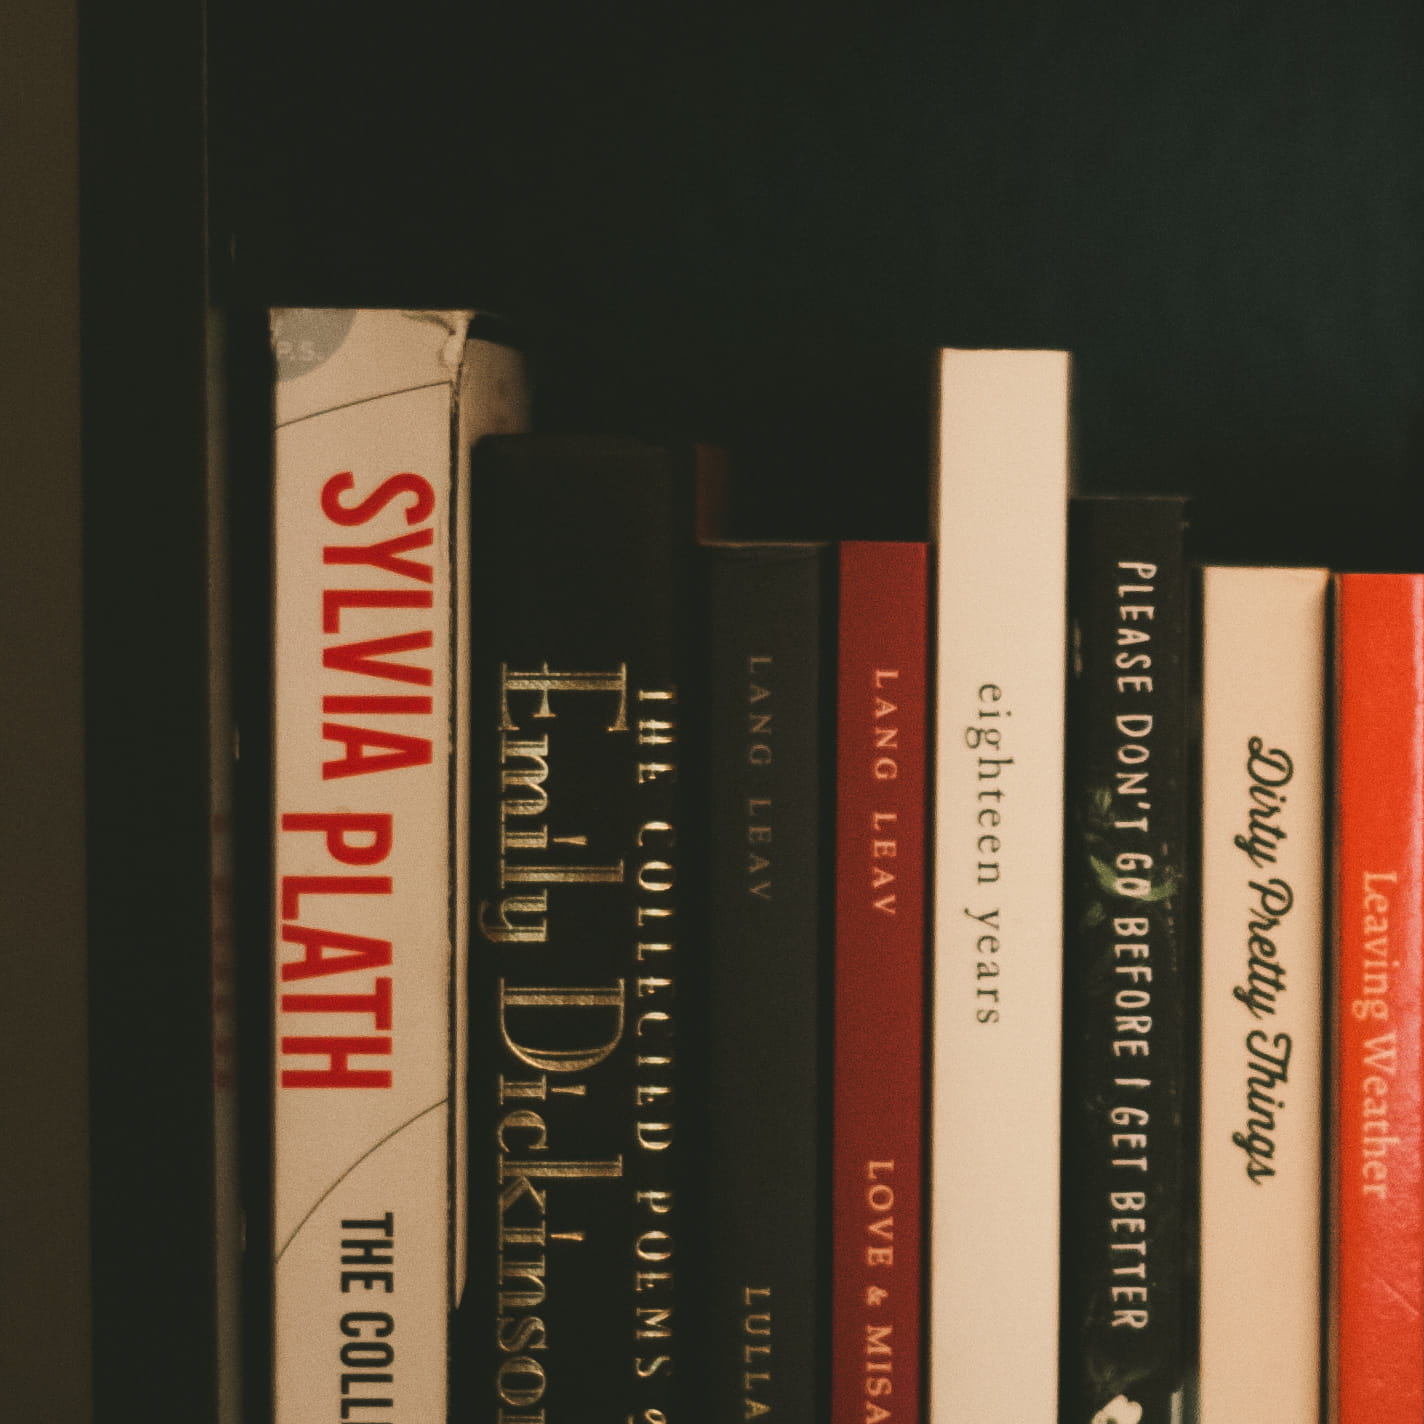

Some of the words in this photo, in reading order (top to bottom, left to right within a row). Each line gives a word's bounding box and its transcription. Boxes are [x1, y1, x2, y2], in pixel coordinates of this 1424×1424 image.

[320, 470, 437, 781] SYLVIA
[1114, 560, 1159, 695] PLEASE
[635, 683, 680, 784] THE
[748, 655, 775, 766] LANG
[870, 667, 899, 783] LANG
[1114, 713, 1152, 835] DON'T
[476, 659, 631, 945] Emily
[747, 797, 774, 904] LEAV
[963, 681, 1017, 888] eighteen
[1234, 736, 1294, 868] Dirty
[870, 810, 898, 919] LEAV
[1112, 851, 1151, 896] GO
[280, 811, 394, 1090] PLATH
[633, 819, 680, 1153] COLLECTED
[963, 906, 1005, 1027] years
[1111, 916, 1153, 1058] BEFORE
[1231, 877, 1294, 1021] Pretty
[1350, 870, 1400, 1022] Leaving
[1109, 1105, 1150, 1173] GET
[1114, 1076, 1152, 1088] I
[1230, 1029, 1294, 1187] Things
[1360, 1030, 1399, 1201] Weather
[340, 1211, 395, 1294] THE
[863, 1158, 895, 1269] LOVE
[1110, 1189, 1150, 1330] BETTER
[631, 1189, 676, 1379] POEMS
[864, 1284, 890, 1307] &
